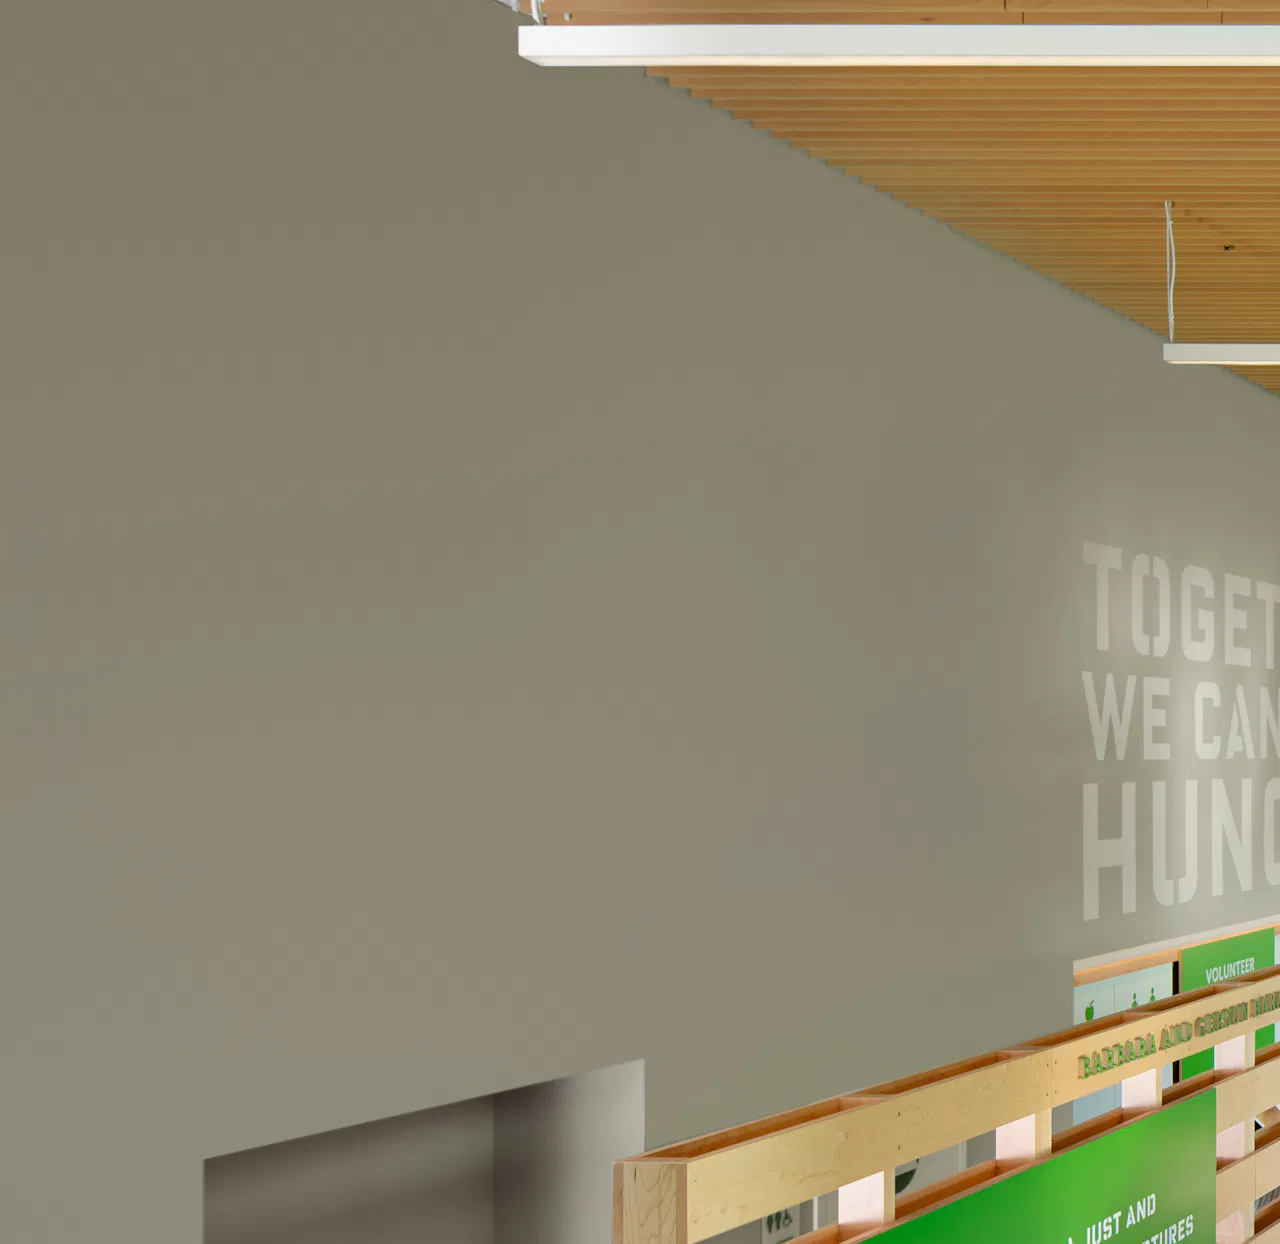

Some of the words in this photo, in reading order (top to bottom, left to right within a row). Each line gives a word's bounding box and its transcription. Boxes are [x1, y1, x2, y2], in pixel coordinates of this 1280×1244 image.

[1082, 671, 1171, 761] WE
[1206, 957, 1255, 984] VOLUNTEER
[1078, 1032, 1157, 1079] BARBARA
[1159, 1019, 1194, 1052] AND
[1195, 999, 1248, 1037] GERSON
[1126, 1193, 1156, 1228] AND
